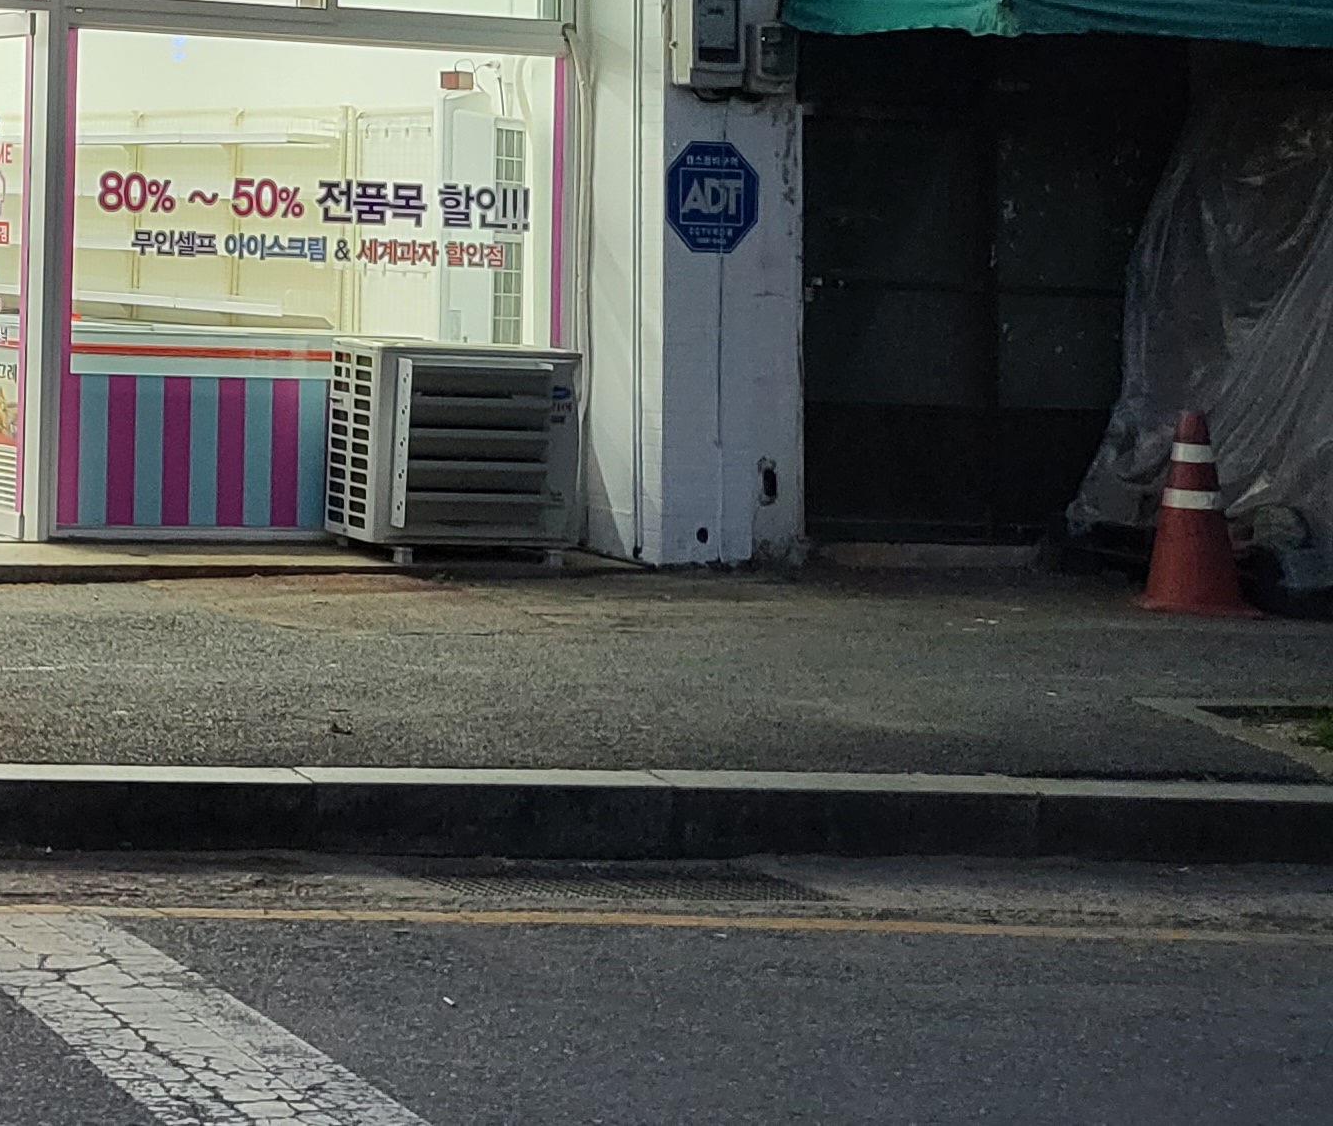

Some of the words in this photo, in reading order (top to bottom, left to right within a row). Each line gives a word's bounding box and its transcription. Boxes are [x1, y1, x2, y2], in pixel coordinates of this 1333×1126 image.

[98, 170, 176, 213] 80%
[231, 177, 305, 218] 50%
[316, 179, 428, 228] 전품목
[680, 177, 743, 215] ADT
[131, 229, 218, 257] 무인셀프
[224, 232, 328, 263] 아이스크림
[334, 238, 351, 262] &
[356, 238, 440, 267] 세계과자
[445, 241, 505, 268] 할인점
